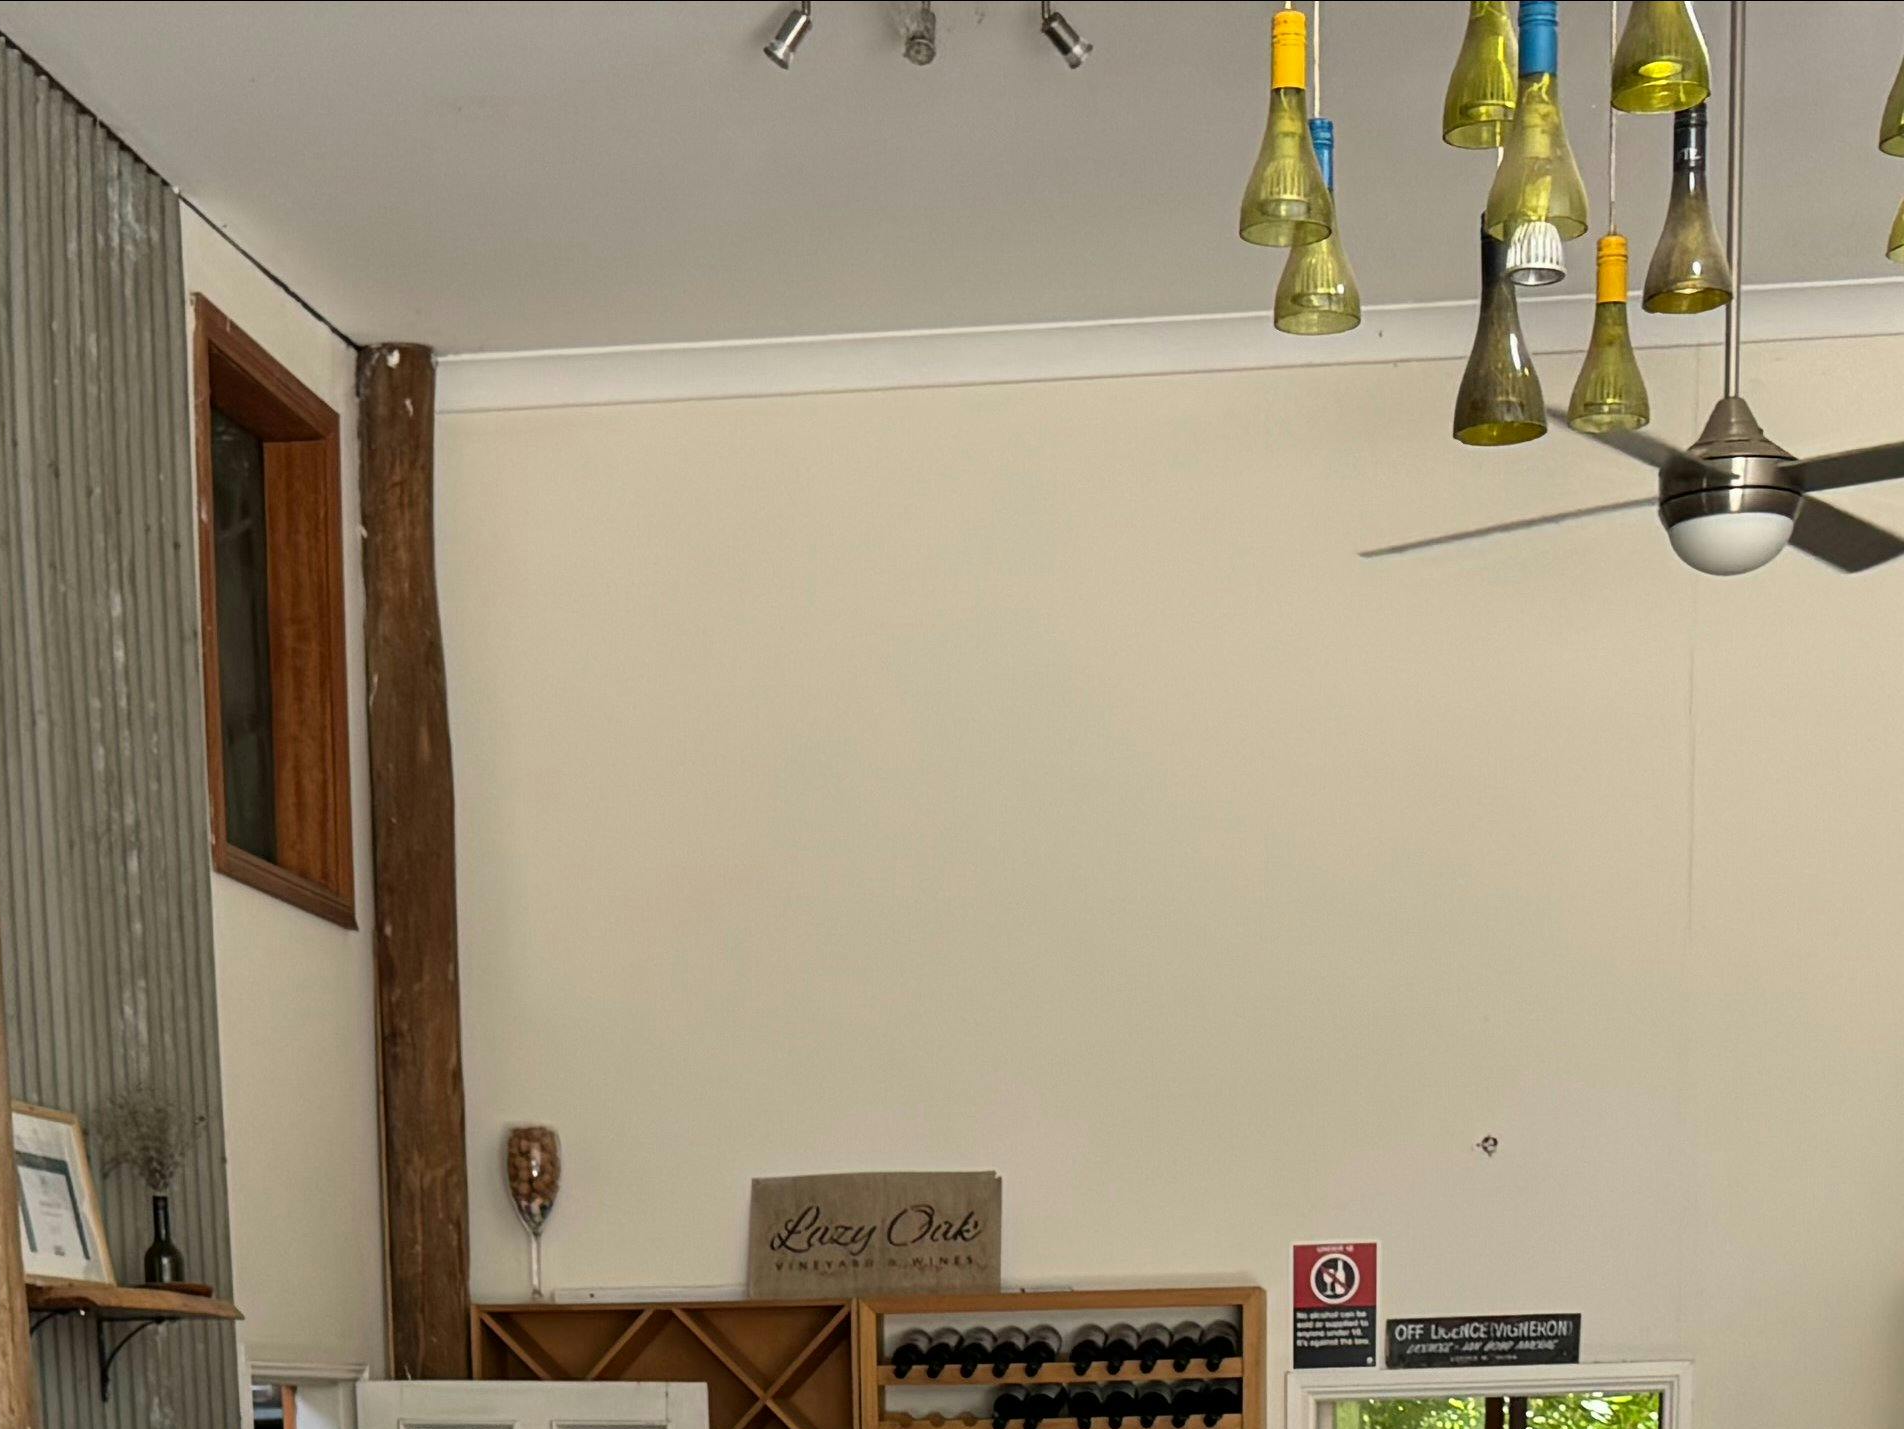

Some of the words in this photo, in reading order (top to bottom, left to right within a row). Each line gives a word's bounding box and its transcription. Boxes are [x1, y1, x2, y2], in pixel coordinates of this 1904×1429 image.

[770, 1205, 877, 1257] Lazy
[887, 1204, 983, 1247] Oak
[912, 1255, 974, 1267] WINES
[1395, 1324, 1424, 1341] OFF
